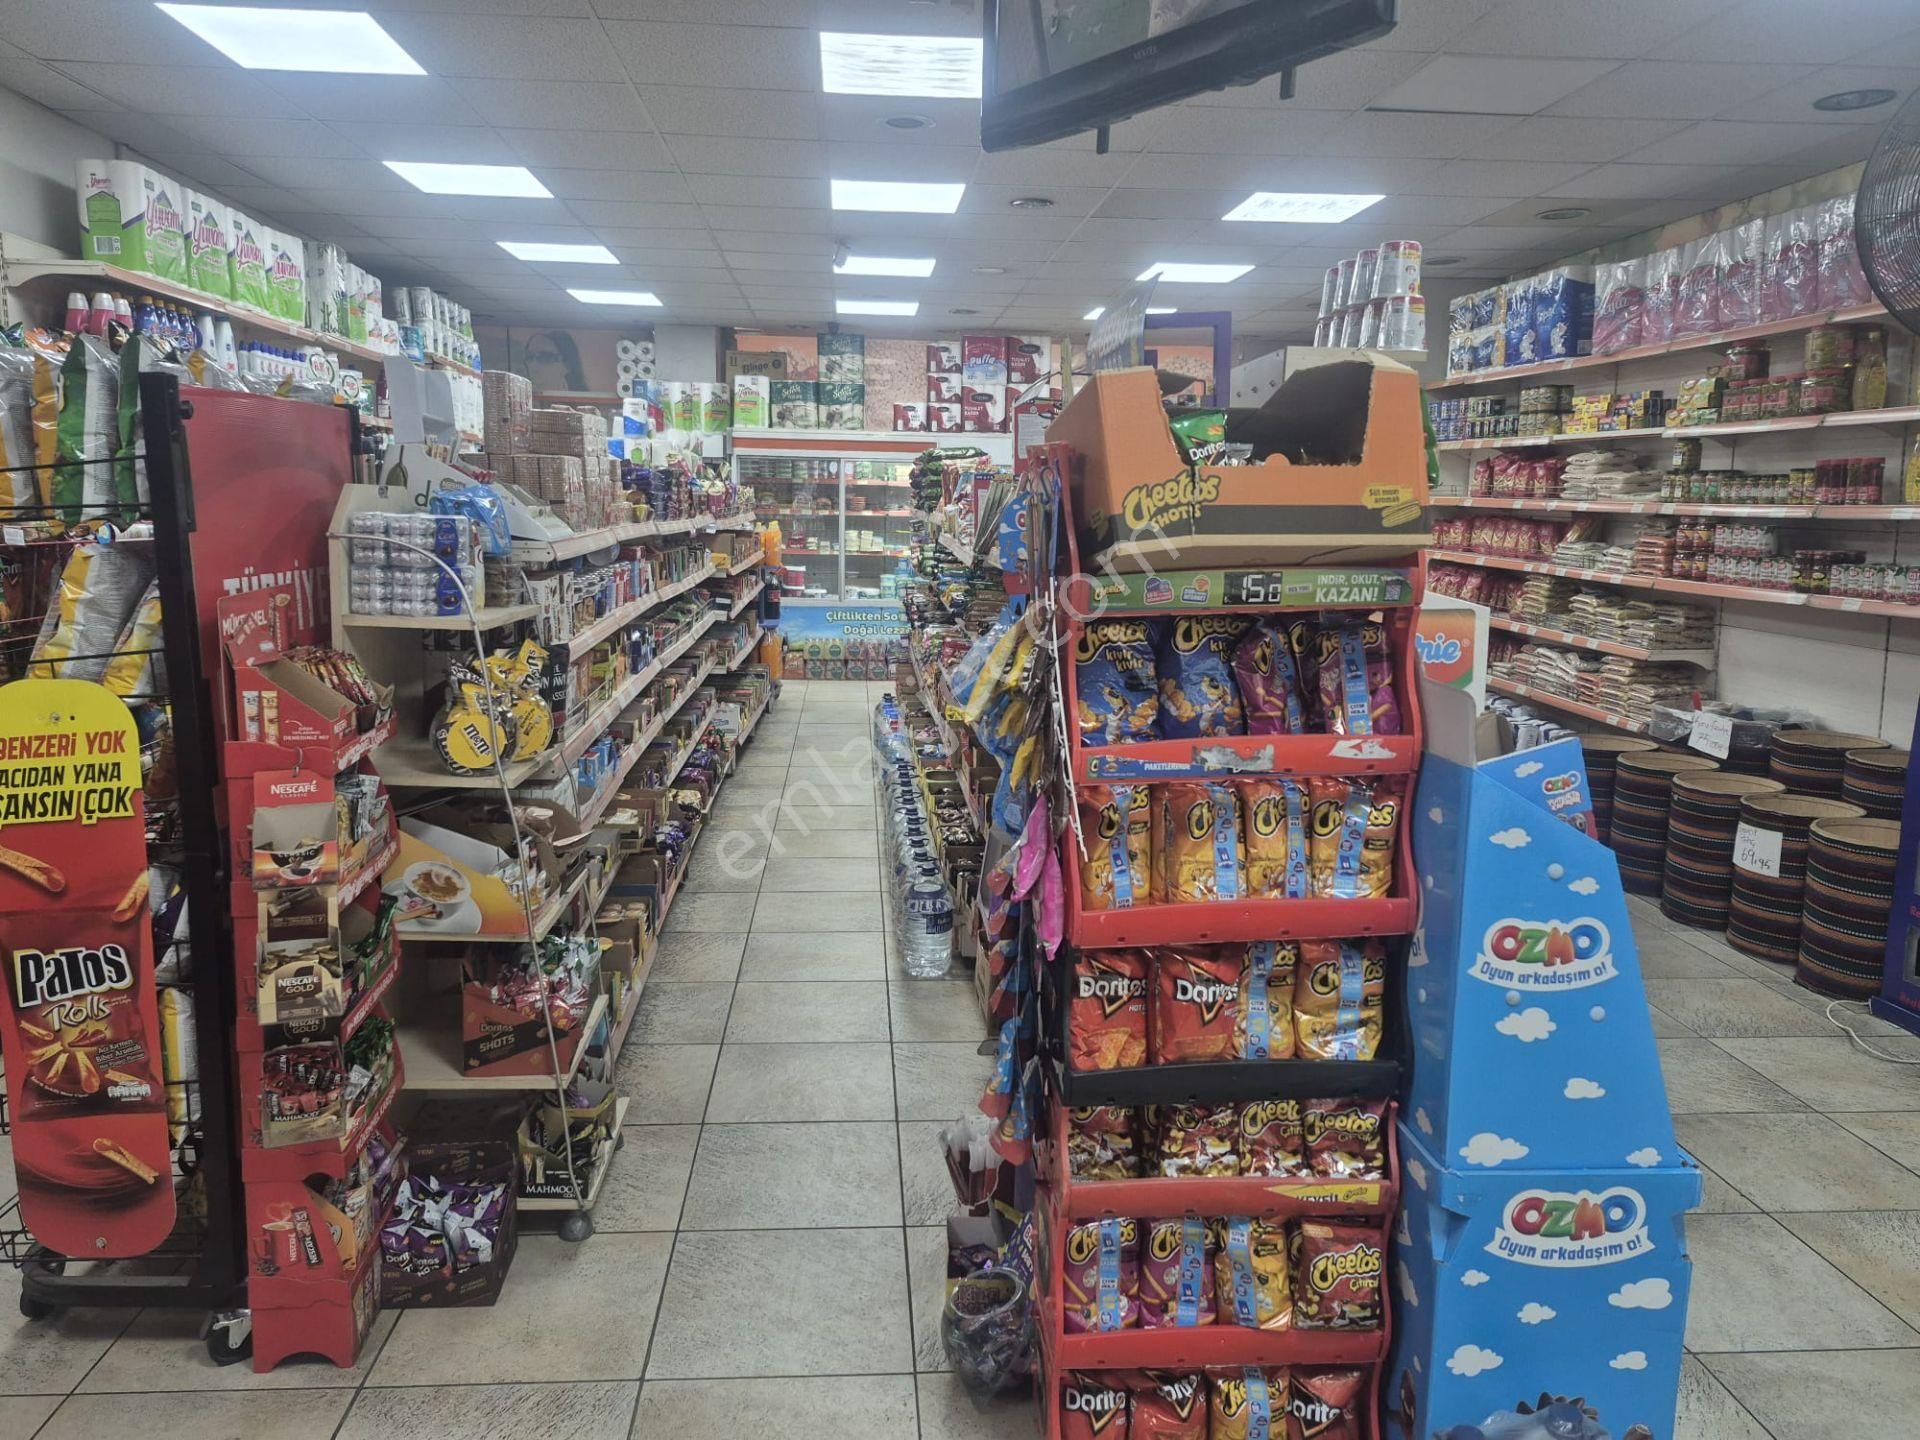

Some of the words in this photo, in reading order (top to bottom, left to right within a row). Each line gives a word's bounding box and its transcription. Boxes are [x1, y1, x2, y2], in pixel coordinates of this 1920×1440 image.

[1123, 468, 1221, 529] Cheetos
[1316, 587, 1378, 602] KAZAN!
[844, 624, 878, 635] Doğal
[85, 730, 126, 755] YOK
[0, 766, 65, 788] ACIDAN
[73, 762, 121, 784] YANA
[271, 779, 318, 794] NESCAFÉ
[84, 786, 130, 820] ÇOK
[1491, 924, 1603, 968] OZMO
[1480, 961, 1514, 982] Oyun
[1518, 970, 1590, 985] arkadaşım
[285, 983, 315, 994] GOLD
[42, 995, 112, 1032] Rolls
[480, 1034, 515, 1053] SHOTS
[1304, 1108, 1378, 1145] Cheetos
[1511, 1194, 1638, 1241] OZMO
[1499, 1236, 1537, 1258] Oyun
[1541, 1244, 1623, 1262] arkadaşım
[1311, 1244, 1381, 1291] Cheetos
